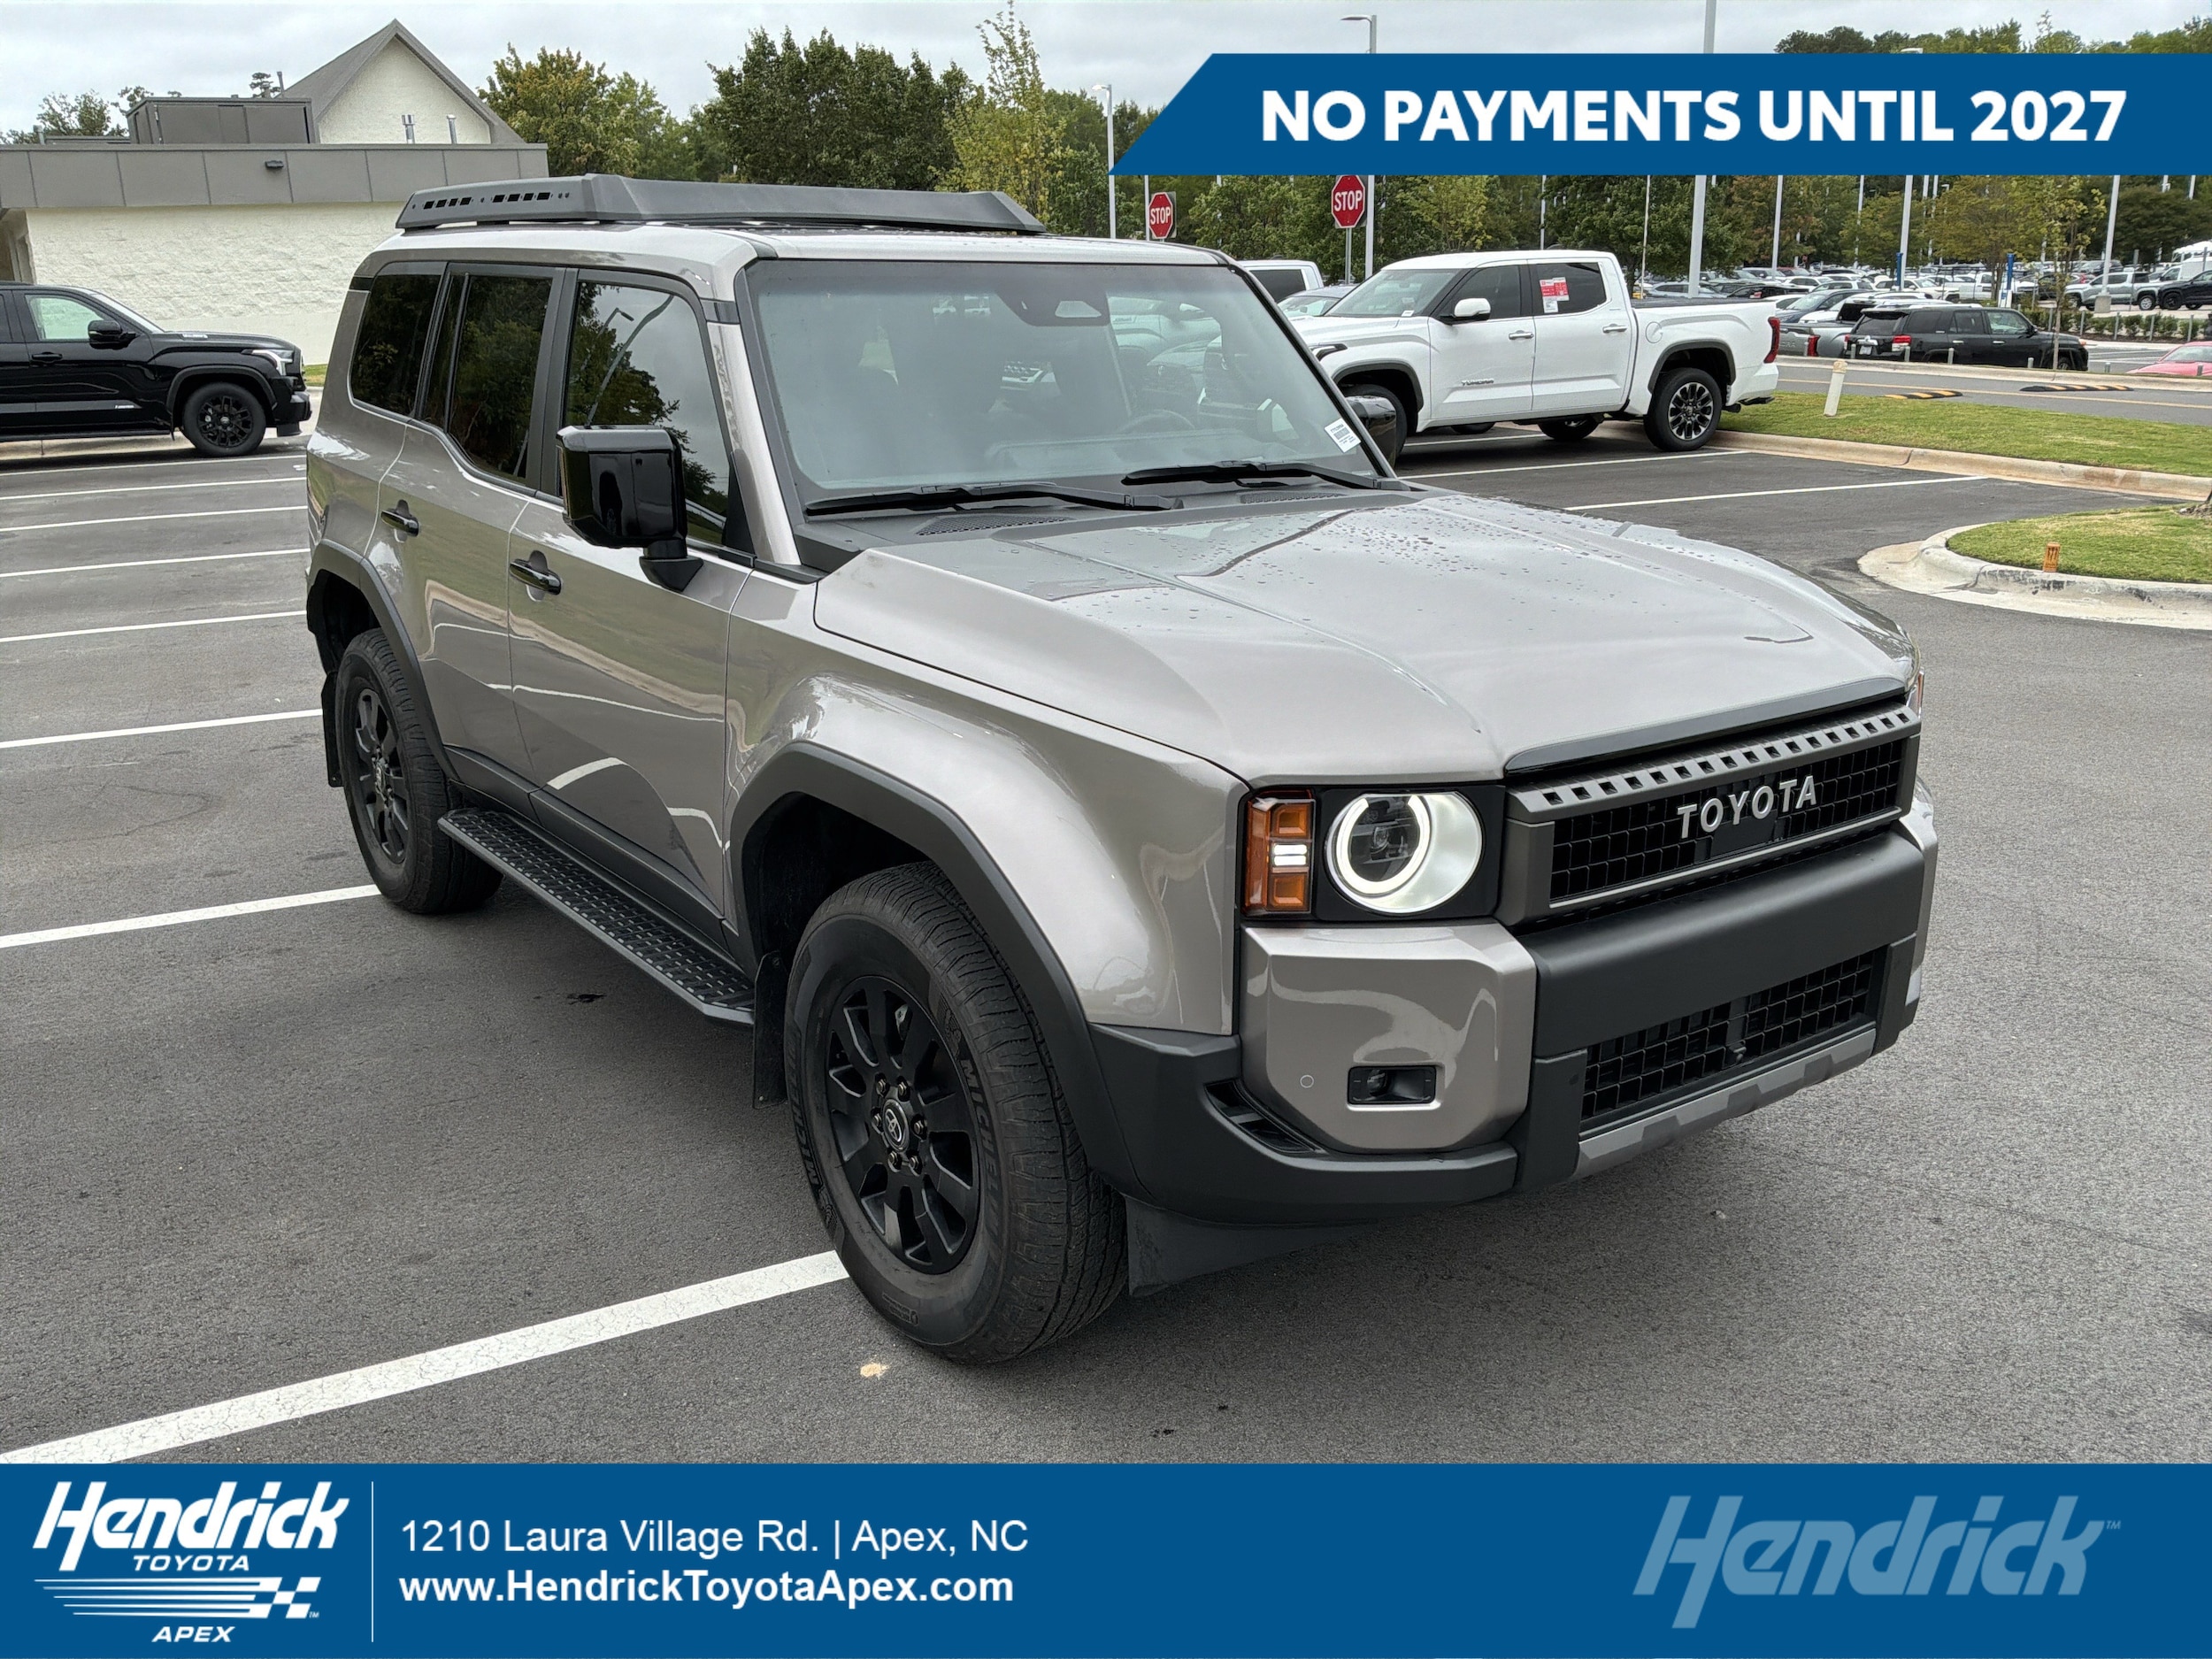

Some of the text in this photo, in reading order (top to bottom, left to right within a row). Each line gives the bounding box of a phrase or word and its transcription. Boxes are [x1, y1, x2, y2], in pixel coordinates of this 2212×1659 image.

[1333, 190, 1363, 211] STOP
[1150, 206, 1171, 225] STOP
[1677, 775, 1817, 839] TOYOTA
